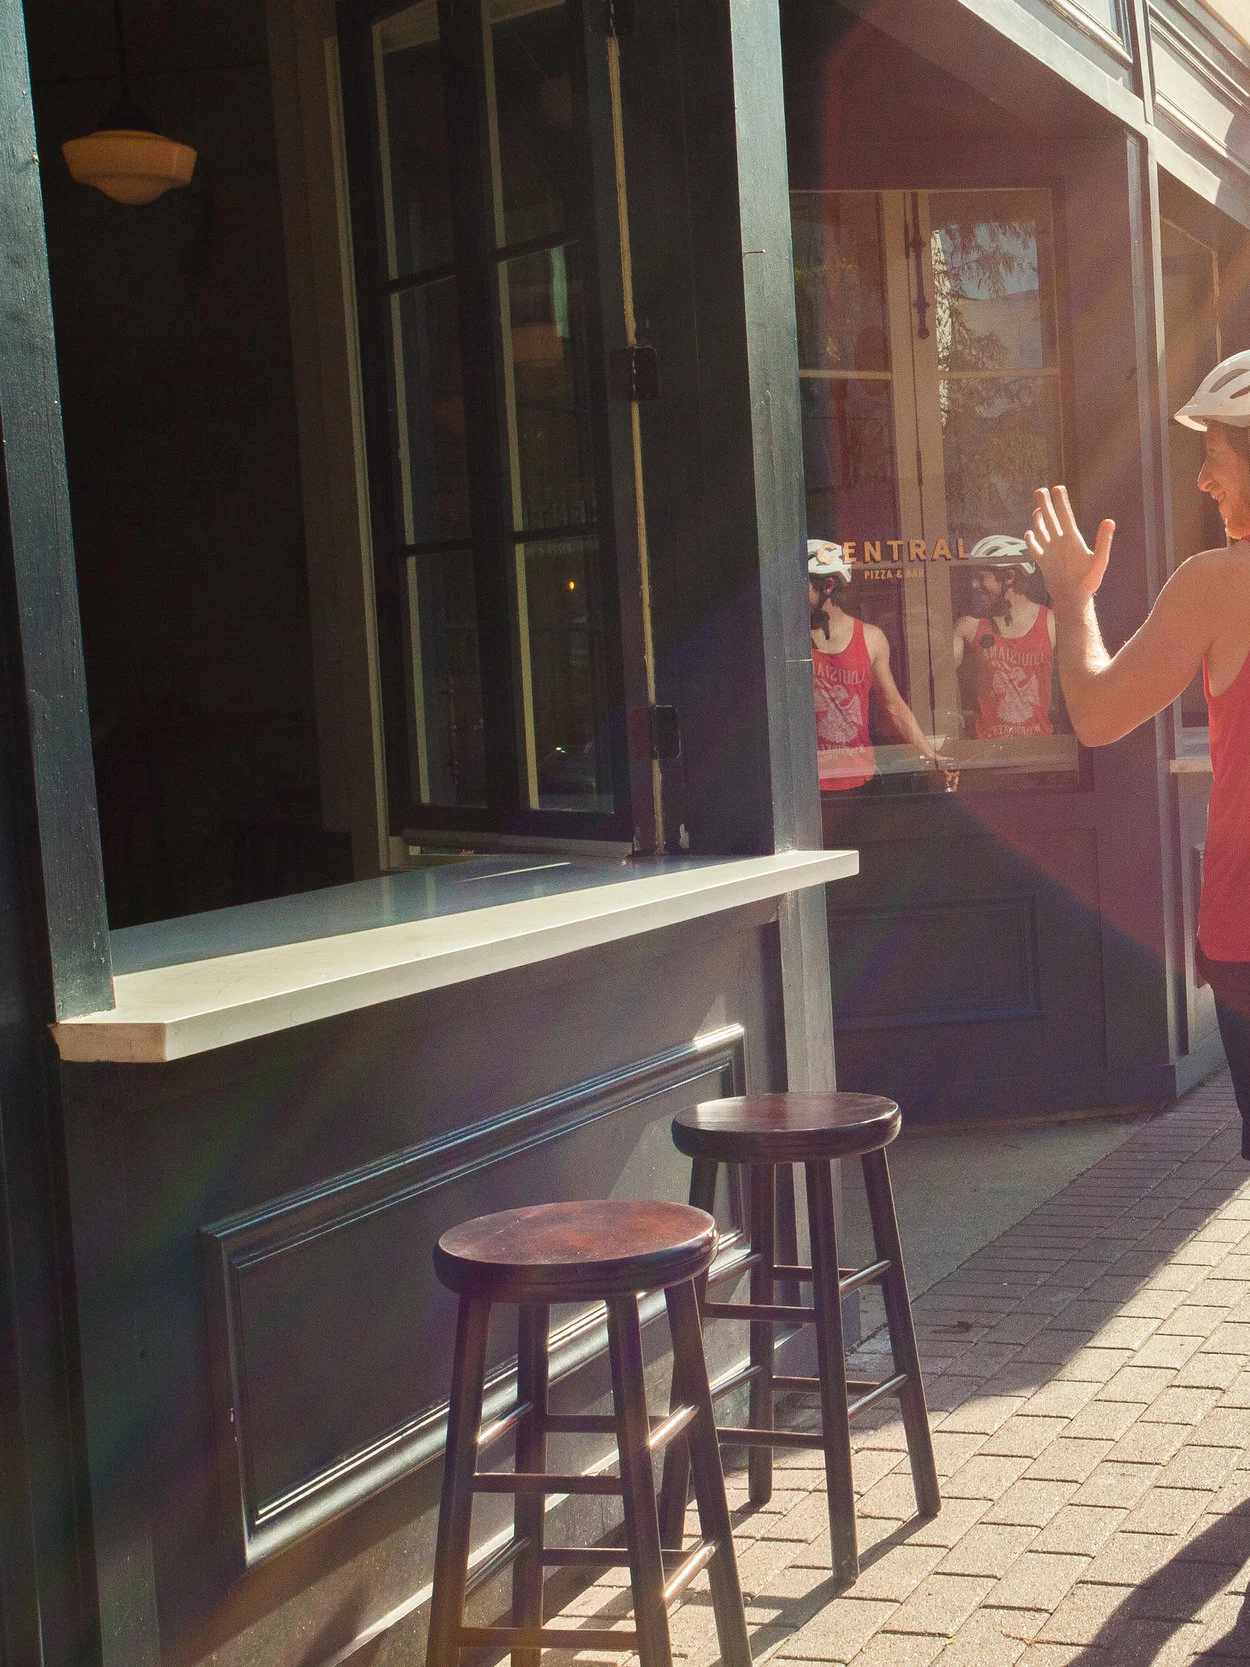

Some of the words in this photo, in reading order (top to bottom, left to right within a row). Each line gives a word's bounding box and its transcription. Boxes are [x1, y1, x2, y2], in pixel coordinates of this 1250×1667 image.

[816, 538, 970, 564] CENTRAL
[864, 570, 893, 580] PIZZA
[896, 569, 903, 578] &
[905, 568, 925, 578] BAR
